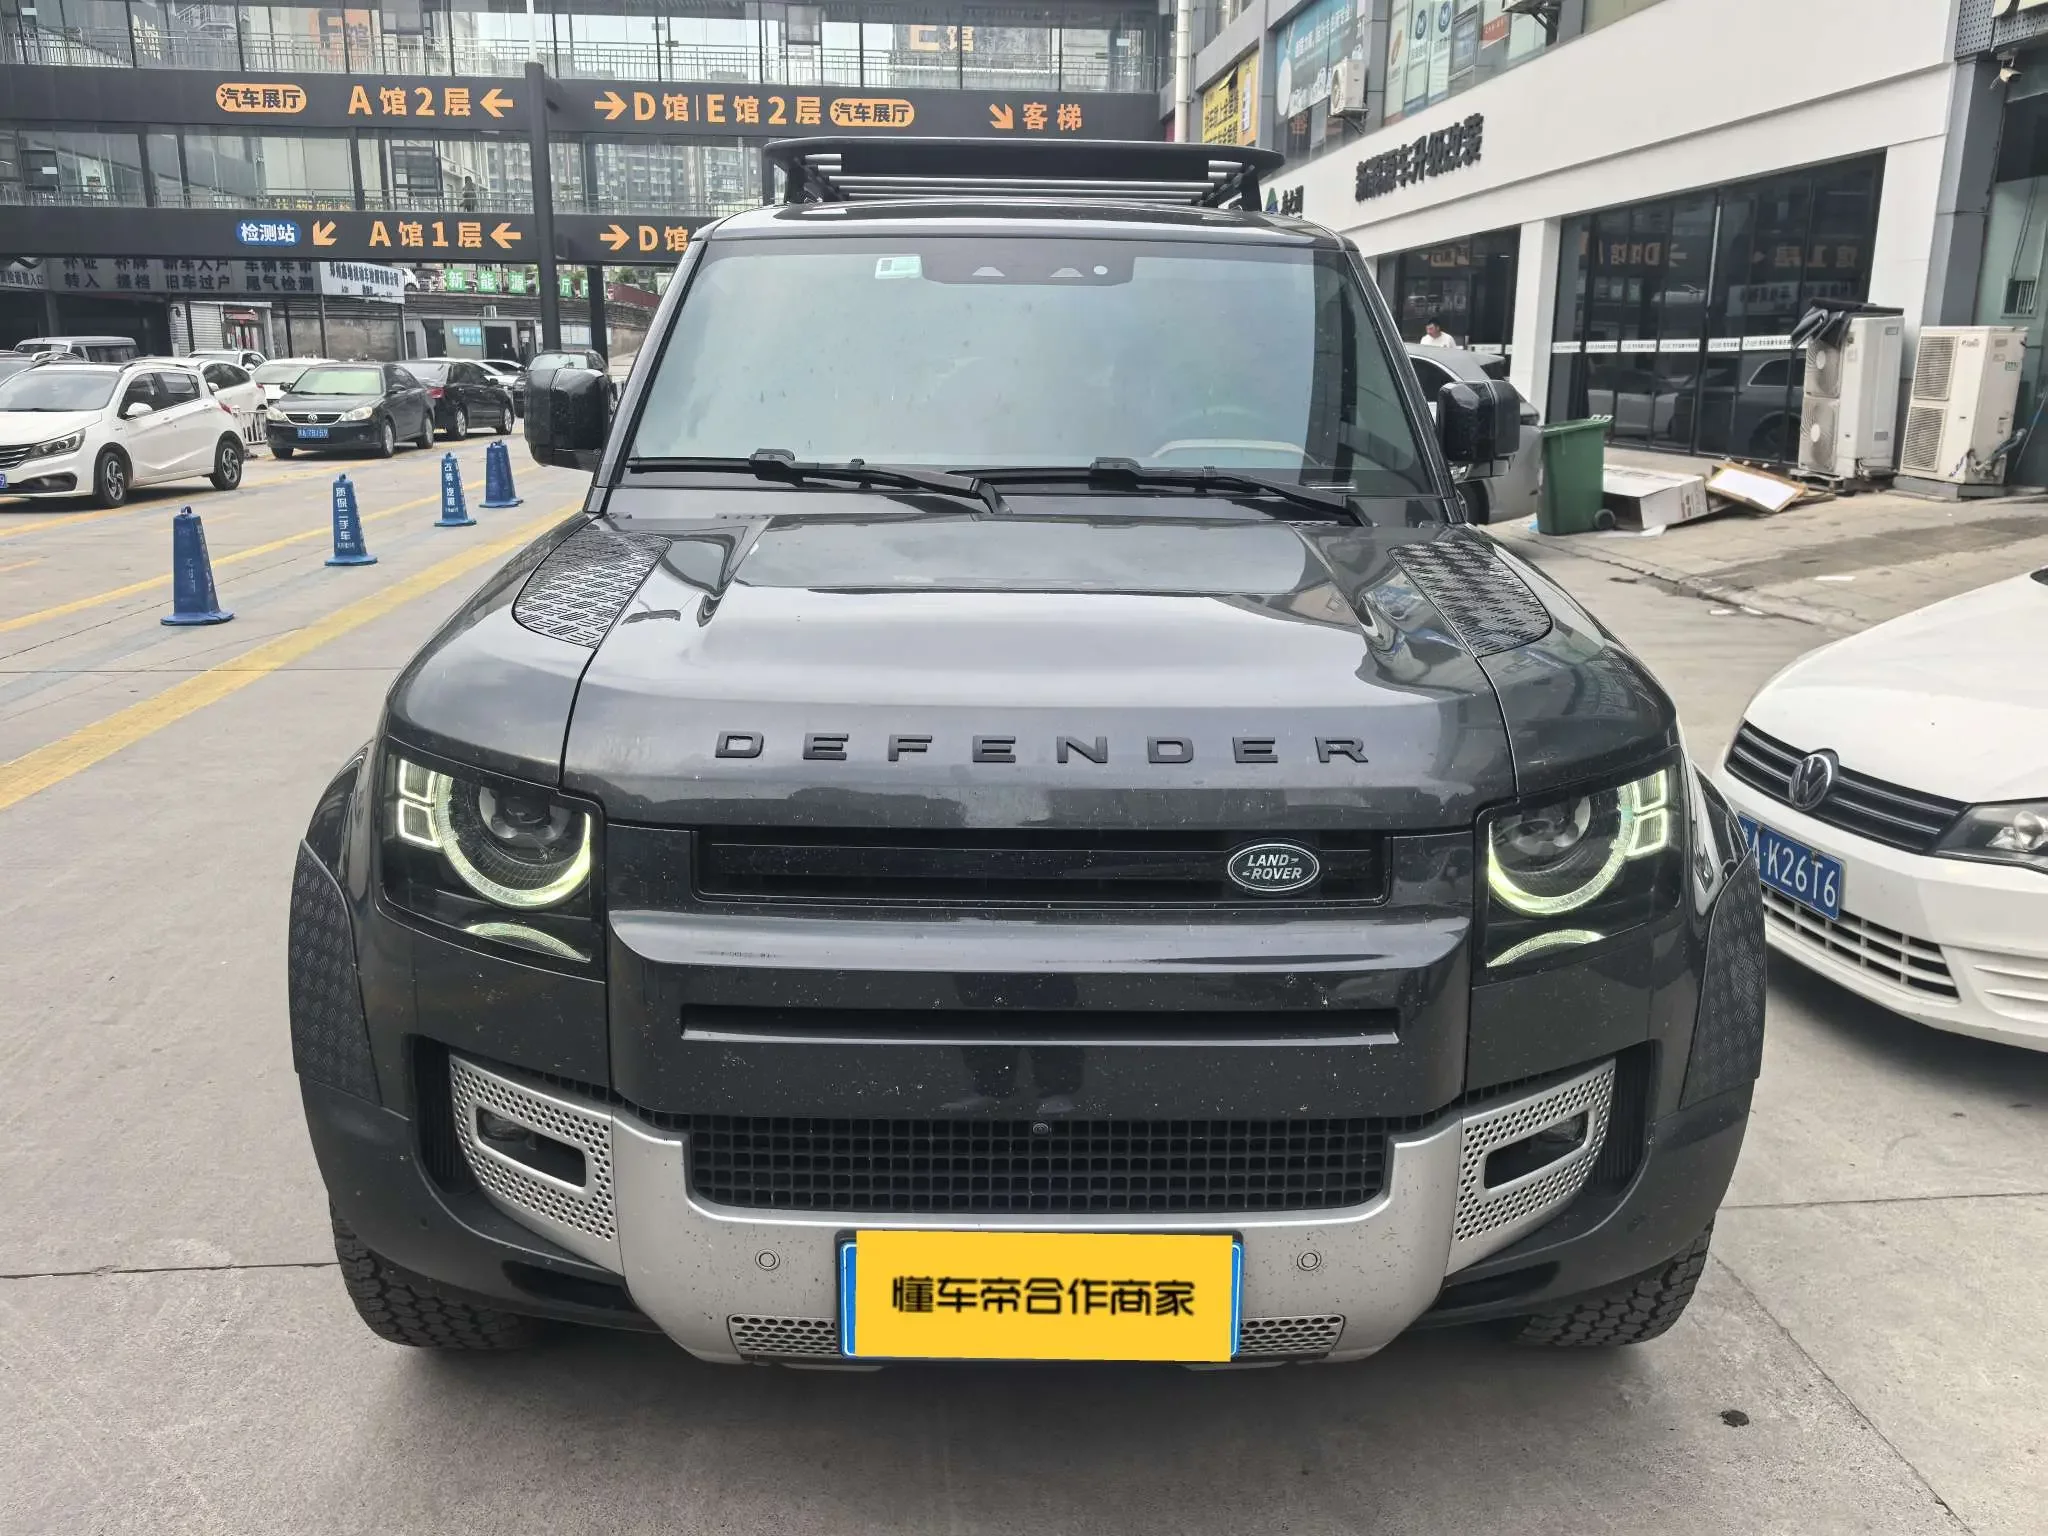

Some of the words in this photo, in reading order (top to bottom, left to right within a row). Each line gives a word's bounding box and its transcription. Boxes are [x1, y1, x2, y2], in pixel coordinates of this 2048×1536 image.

[220, 87, 301, 109] 汽车展厅
[834, 103, 911, 123] 汽车展厅
[1023, 102, 1082, 130] 客梯
[240, 223, 296, 243] 检测站
[639, 225, 688, 251] D馆
[64, 273, 100, 289] 转入
[166, 274, 230, 290] 旧车过户
[335, 487, 351, 541] 质保二手车
[714, 731, 1370, 764] DEFENDER
[1247, 854, 1289, 867] LAND
[1251, 867, 1303, 880] ROVER
